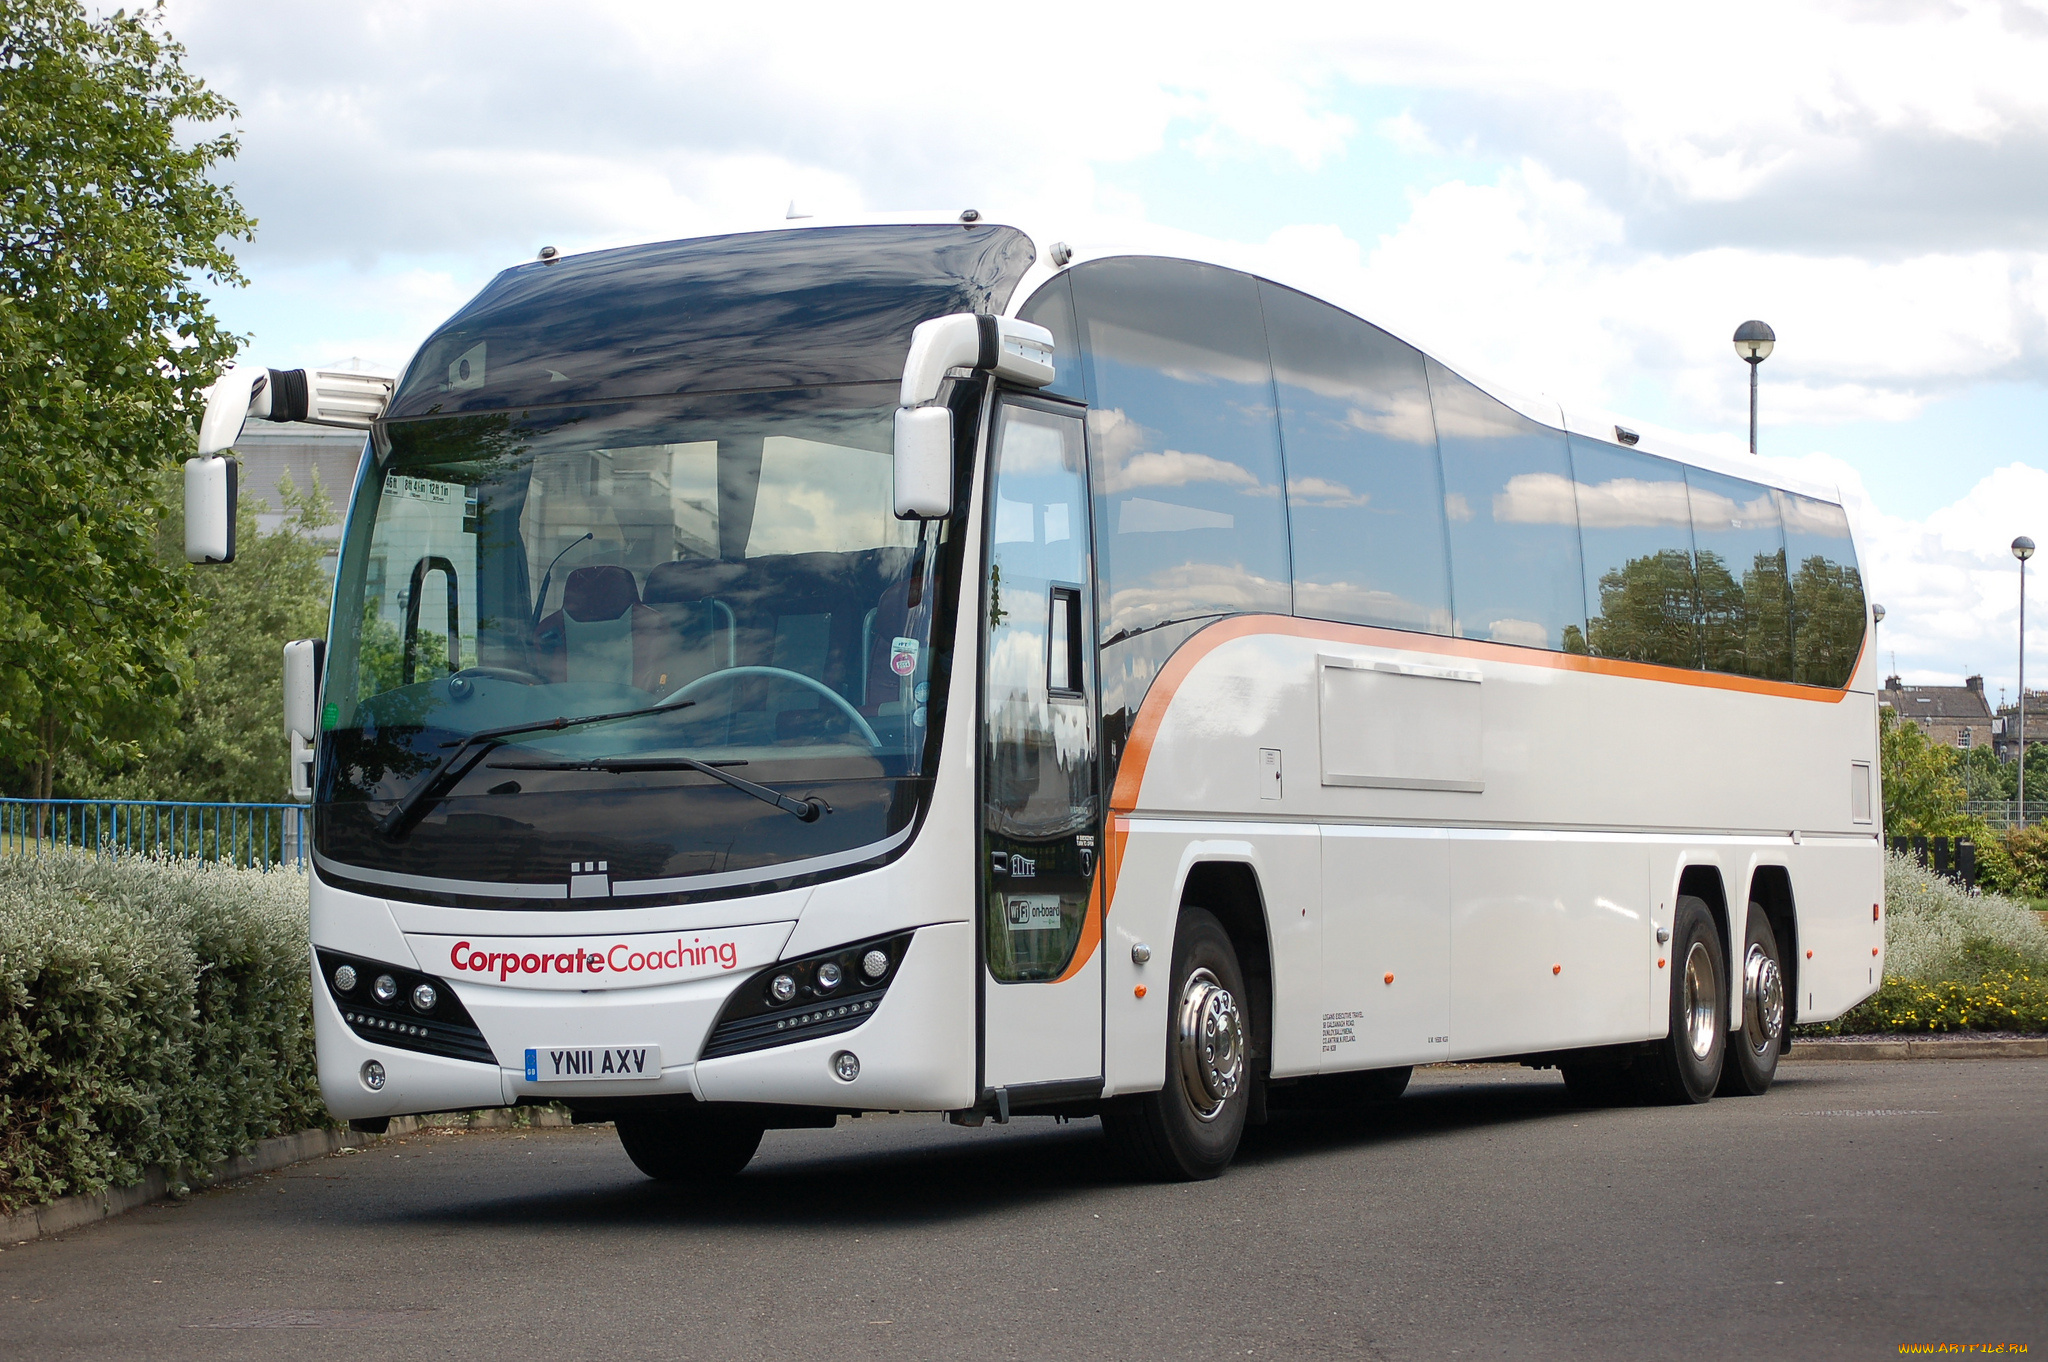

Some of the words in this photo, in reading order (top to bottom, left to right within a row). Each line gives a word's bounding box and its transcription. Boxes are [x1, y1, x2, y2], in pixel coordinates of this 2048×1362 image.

[1011, 855, 1035, 877] ELITE
[1032, 903, 1060, 918] on-board
[601, 1049, 646, 1074] AXV
